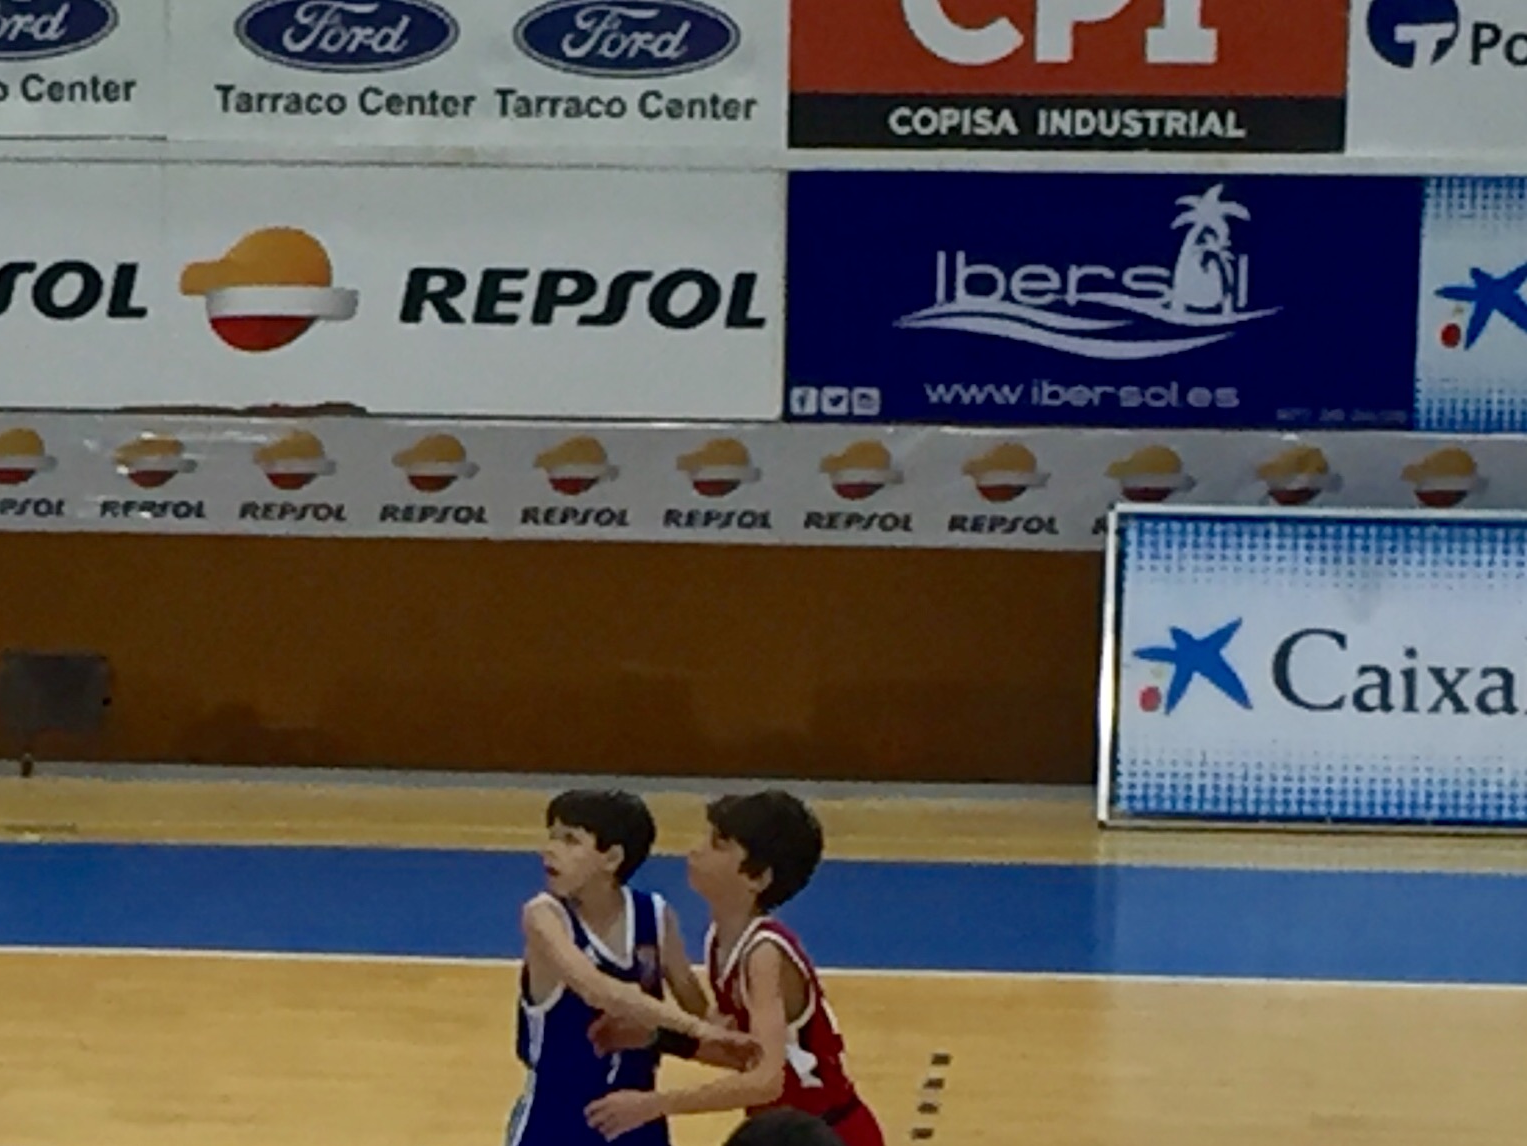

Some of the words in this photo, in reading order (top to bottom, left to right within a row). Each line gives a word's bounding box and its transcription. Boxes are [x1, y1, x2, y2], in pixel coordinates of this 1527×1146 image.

[281, 0, 410, 55] Ford
[561, 4, 689, 60] Ford
[20, 73, 137, 104] Center
[214, 84, 347, 116] Tarraco
[358, 86, 477, 118] Center
[494, 87, 627, 119] Tarraco
[637, 89, 758, 121] Center
[888, 106, 1019, 136] COPISA
[1037, 108, 1246, 139] INDUSTRIAL
[399, 266, 766, 330] REPSOL
[239, 501, 348, 522] REPSOL
[379, 504, 487, 525] REPSOL
[520, 506, 629, 527] REPSOL
[663, 508, 772, 530] REPSOL
[803, 511, 913, 532] REPSOL
[947, 514, 1059, 535] REPSOL
